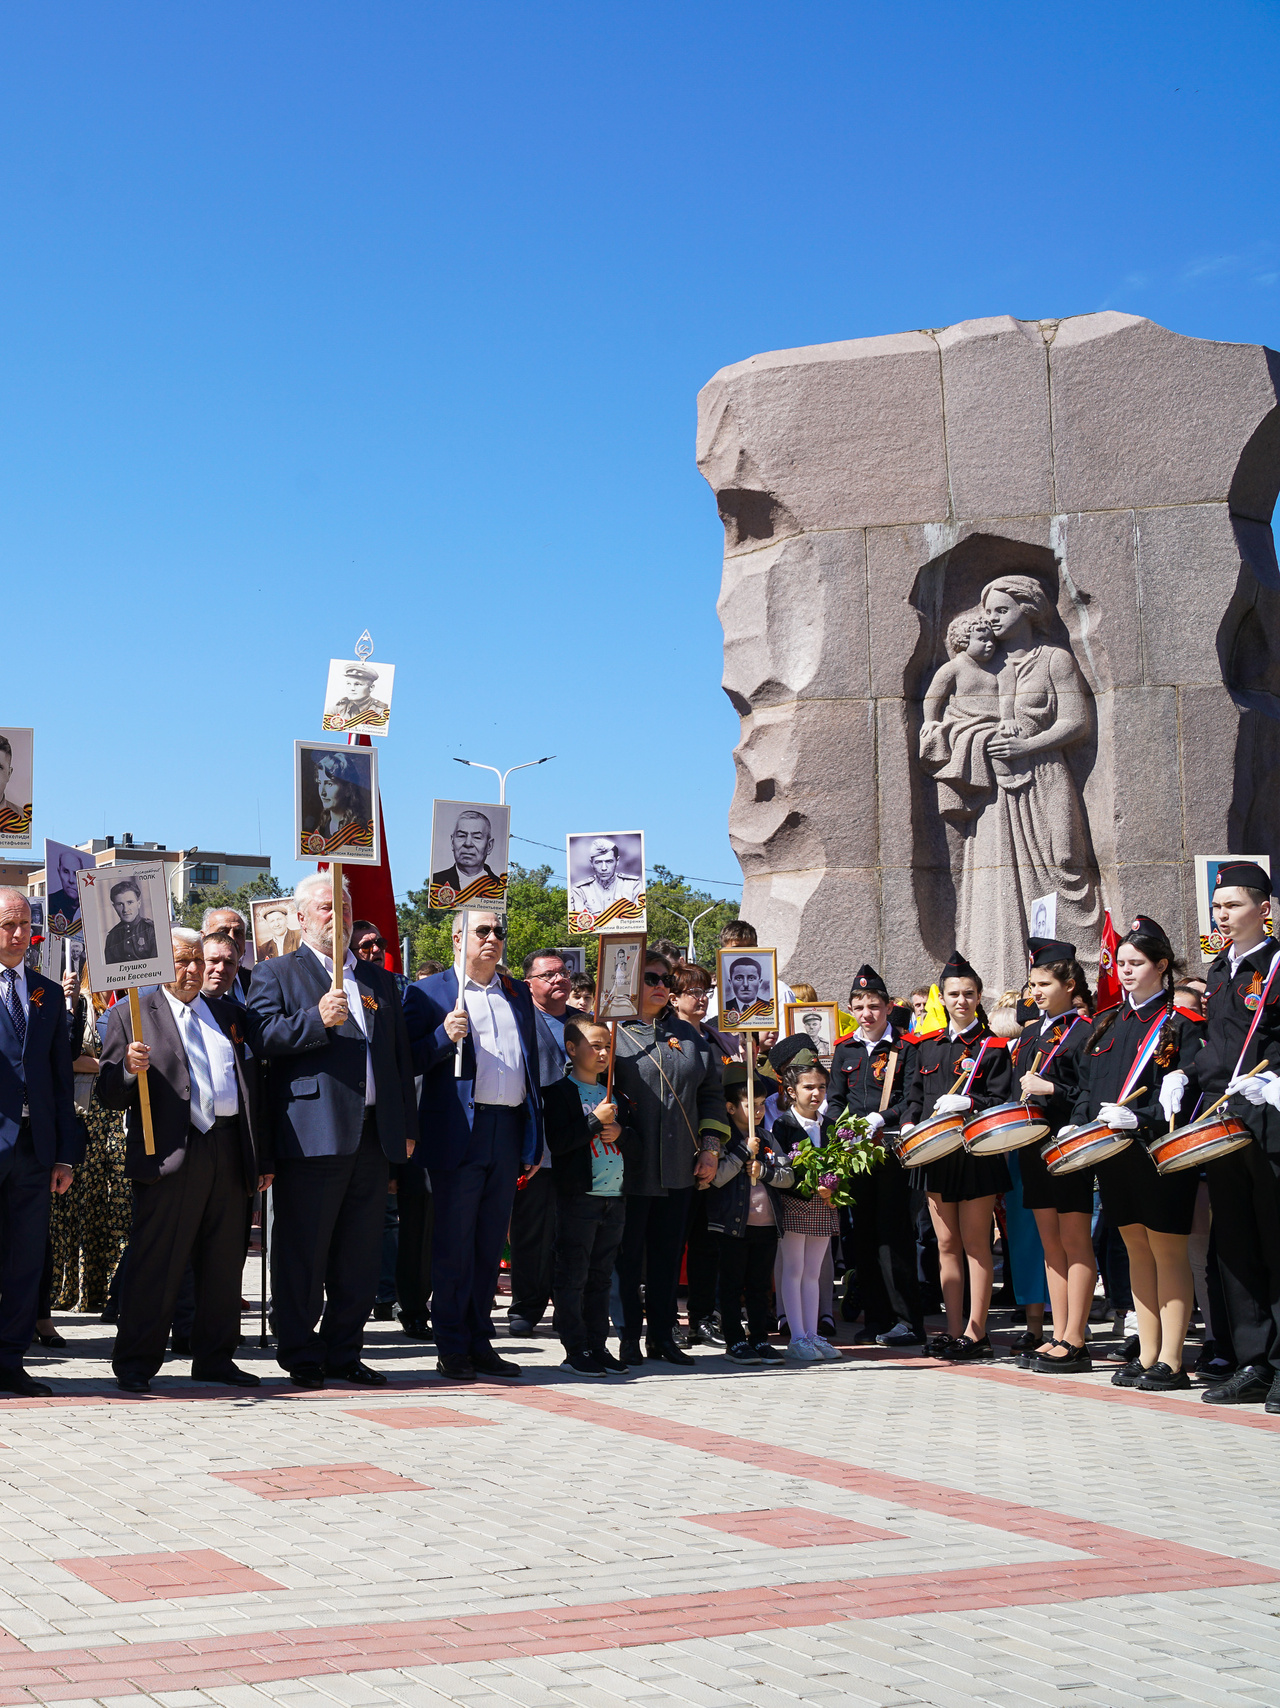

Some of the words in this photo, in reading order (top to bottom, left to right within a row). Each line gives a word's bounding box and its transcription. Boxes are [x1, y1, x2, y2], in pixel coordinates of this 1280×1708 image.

[119, 962, 147, 972] Глушко
[106, 974, 126, 983] Иван
[127, 971, 162, 981] Евсеевич
